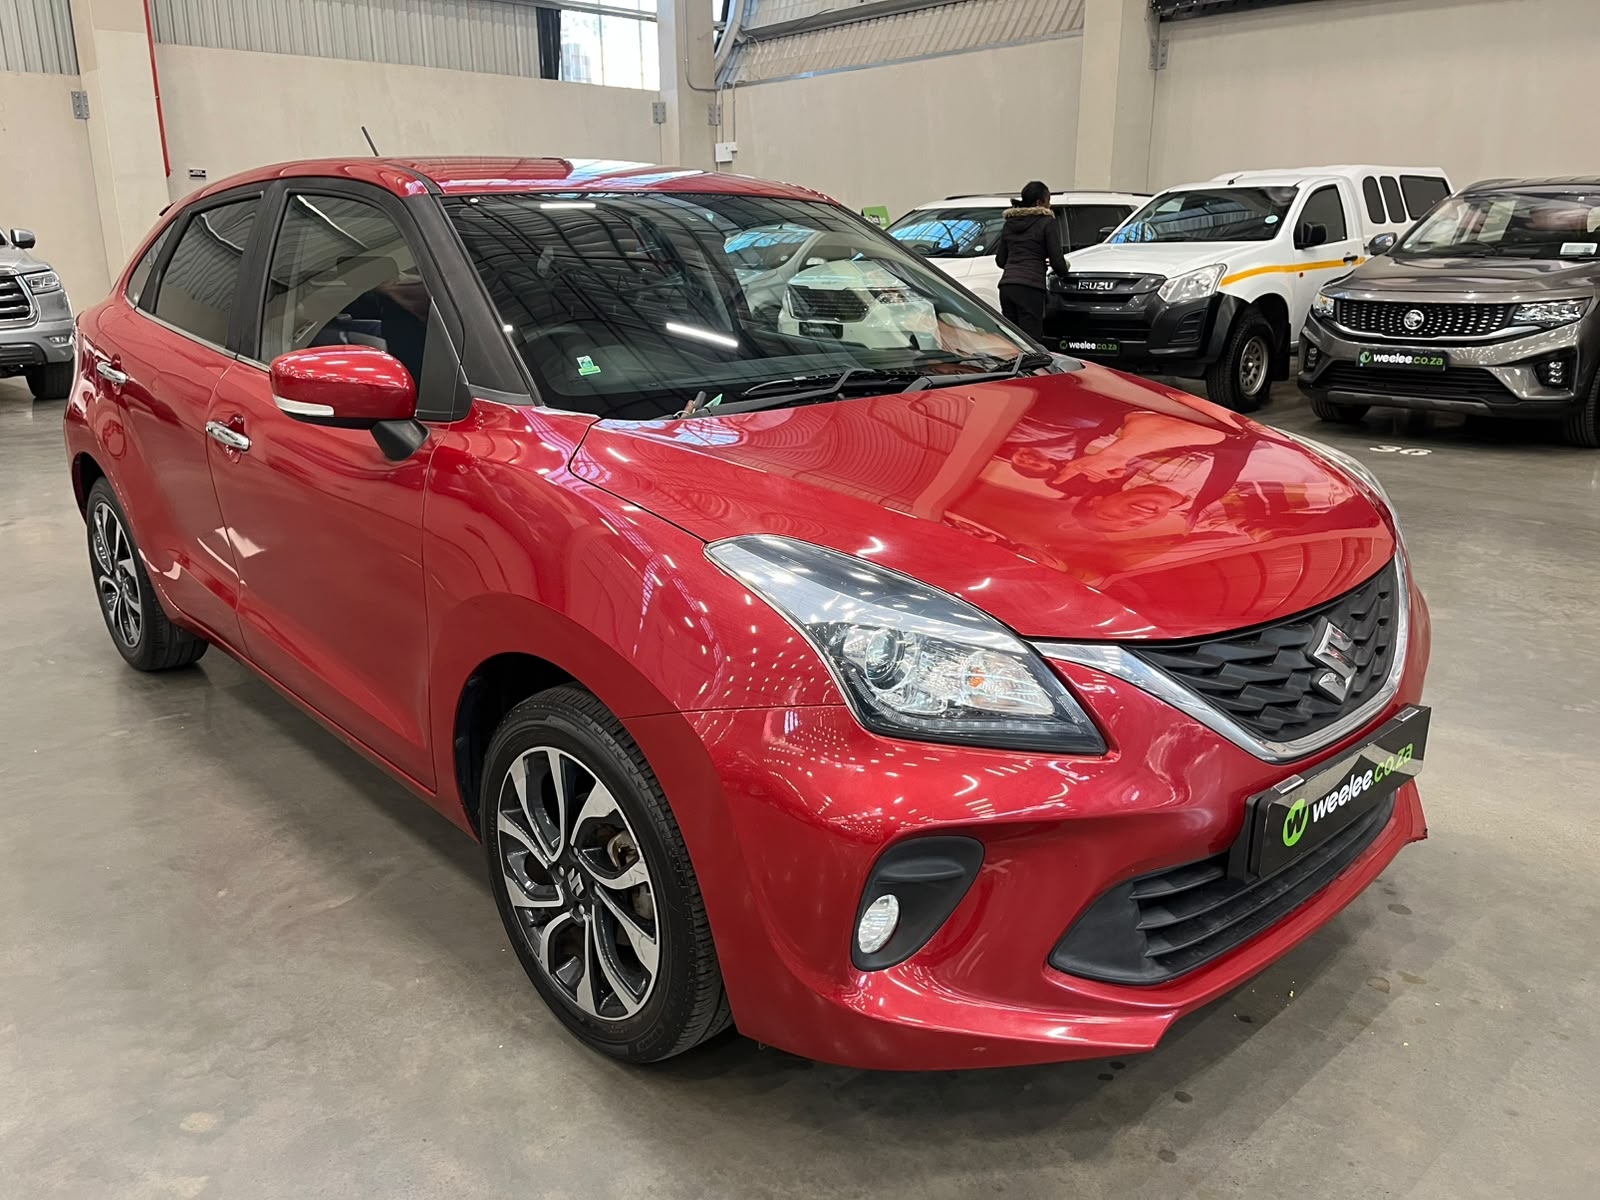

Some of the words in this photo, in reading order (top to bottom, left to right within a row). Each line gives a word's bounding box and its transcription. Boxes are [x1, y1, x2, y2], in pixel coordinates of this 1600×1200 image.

[1078, 281, 1114, 290] ISUZU
[1369, 445, 1432, 456] 36
[1312, 743, 1414, 823] weelee.co.za
